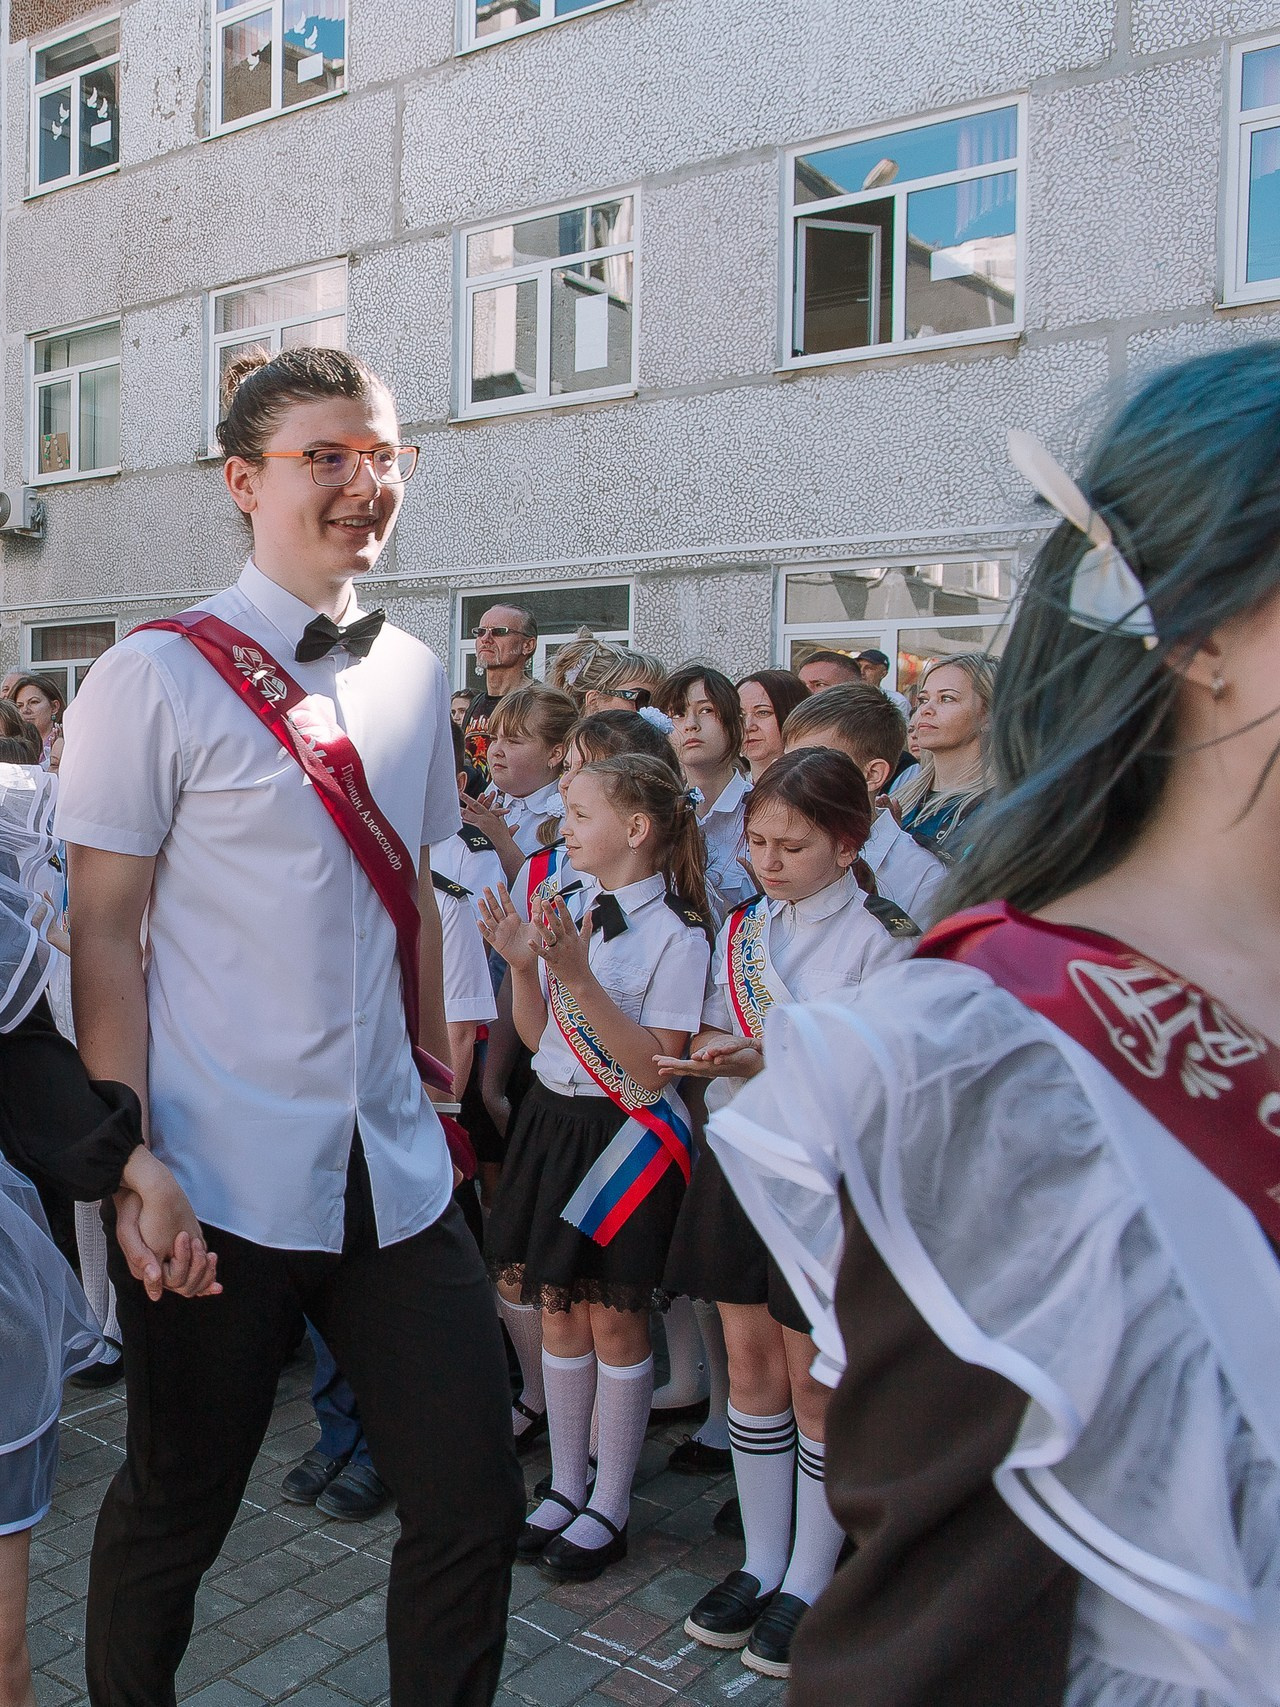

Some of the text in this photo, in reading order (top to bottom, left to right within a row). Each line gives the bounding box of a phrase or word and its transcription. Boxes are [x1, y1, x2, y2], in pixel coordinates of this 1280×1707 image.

[341, 763, 403, 872] Пронин Александр
[470, 834, 489, 847] 33
[890, 918, 913, 930] 33
[568, 1031, 622, 1093] школы
